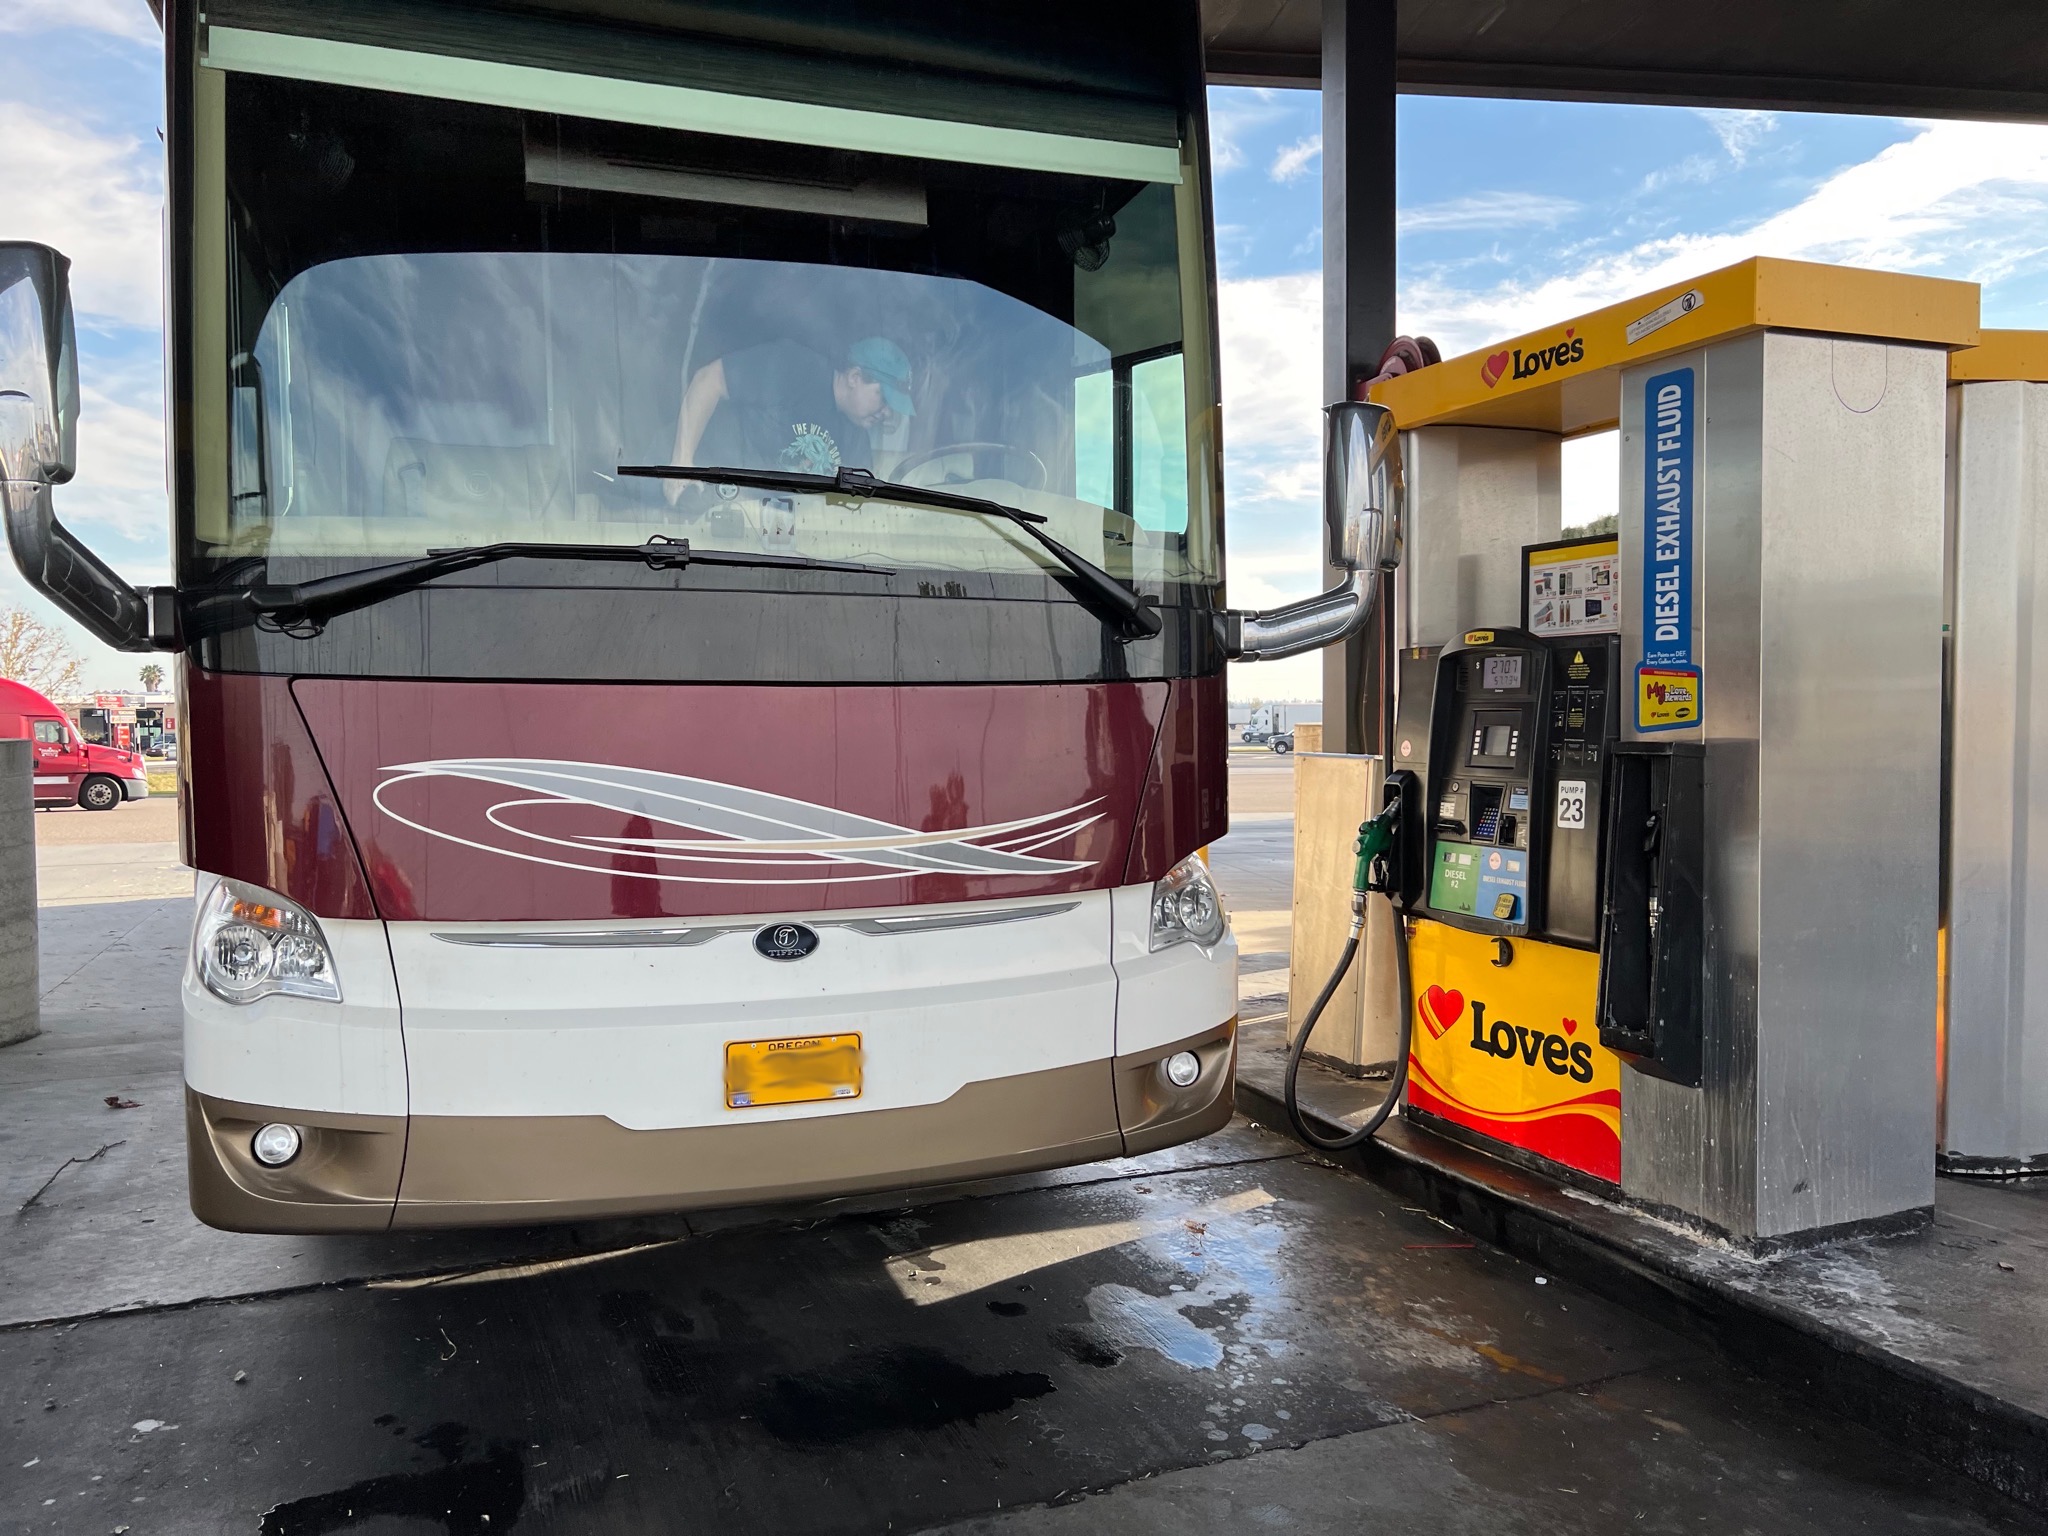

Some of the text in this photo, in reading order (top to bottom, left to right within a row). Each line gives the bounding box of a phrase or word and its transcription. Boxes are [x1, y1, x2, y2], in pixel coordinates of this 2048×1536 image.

[792, 423, 807, 435] THE
[1655, 384, 1682, 641] DIESEL EXHAUST FLUID
[1646, 682, 1666, 705] My
[1670, 685, 1687, 694] Love
[1664, 692, 1692, 702] Rewards
[1560, 798, 1584, 822] 23
[1445, 869, 1466, 880] DIESEL
[1450, 880, 1459, 888] #2
[768, 948, 807, 957] TIFFIN
